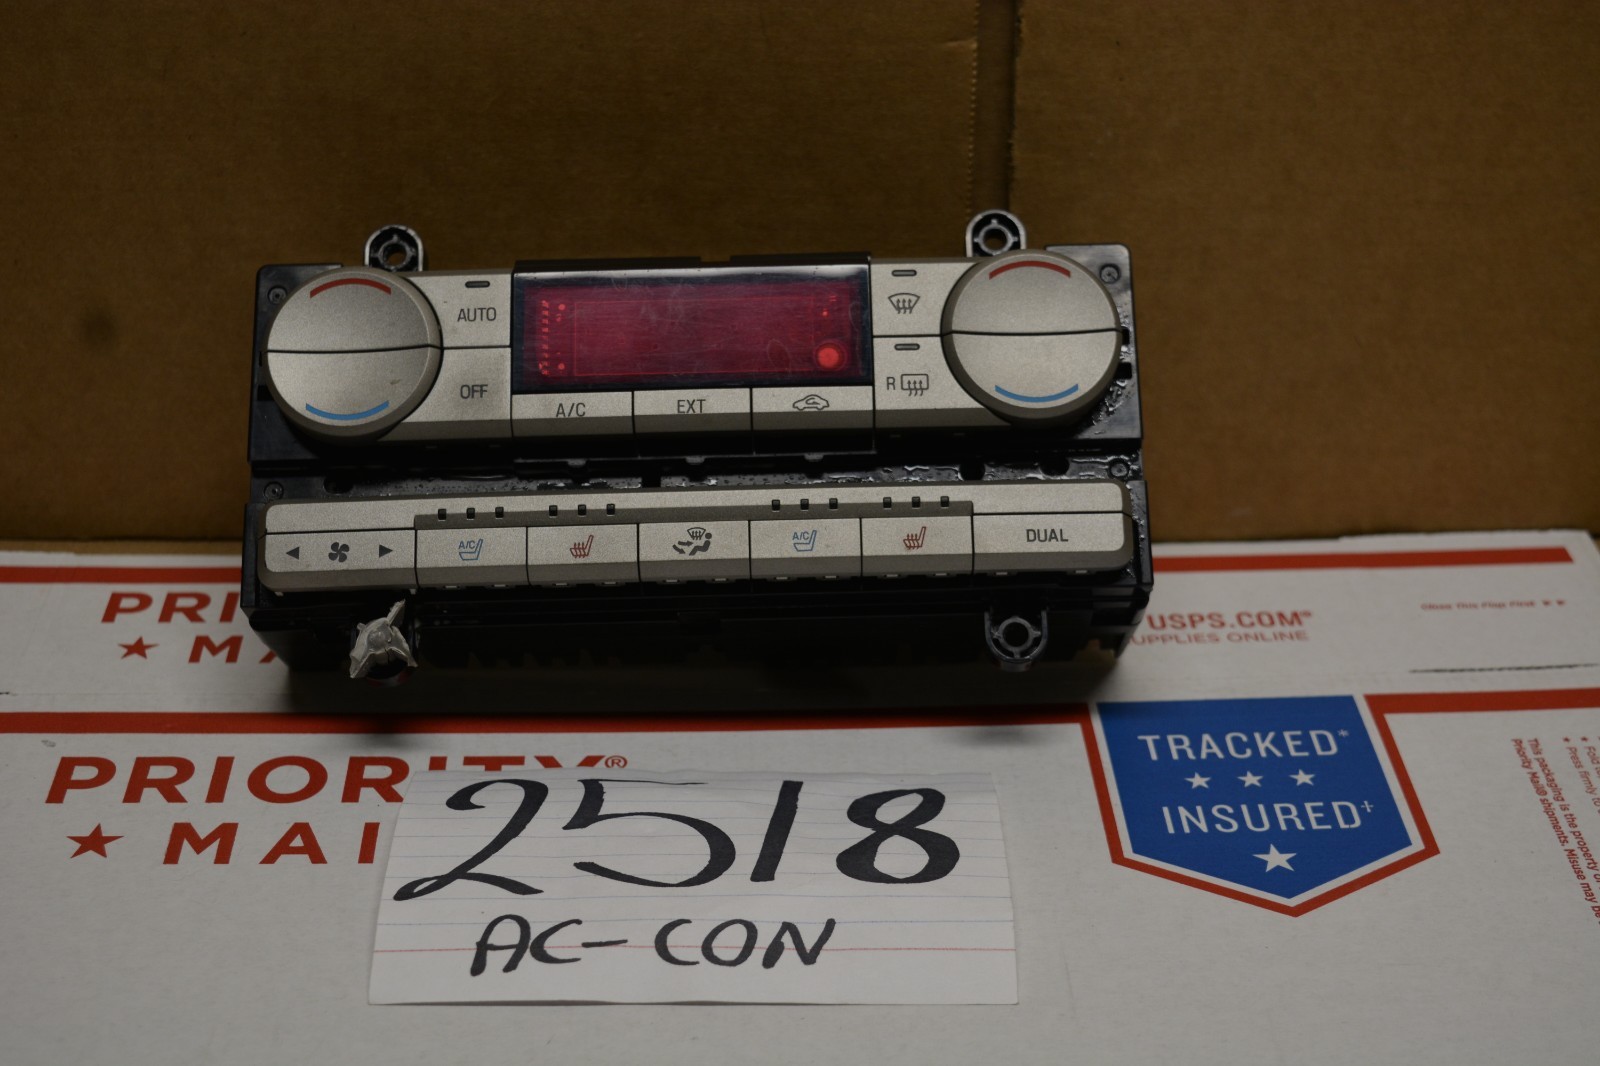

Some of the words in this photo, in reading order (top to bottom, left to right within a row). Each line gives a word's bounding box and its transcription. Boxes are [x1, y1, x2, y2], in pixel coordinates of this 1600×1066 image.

[456, 307, 497, 322] AUTO
[459, 384, 489, 399] OFF
[886, 377, 896, 391] R
[555, 402, 587, 418] A/C
[676, 399, 706, 414] EXT
[1026, 528, 1069, 543] DUAL
[1129, 632, 1220, 646] UPPLIES
[1226, 630, 1310, 643] ONLINE
[1534, 757, 1565, 801] packaging
[1564, 813, 1577, 828] the
[393, 778, 960, 901] 2518
[1540, 798, 1568, 846] shipments.
[1564, 849, 1586, 881] Misuse
[1580, 883, 1598, 903] may
[1570, 830, 1599, 871] property
